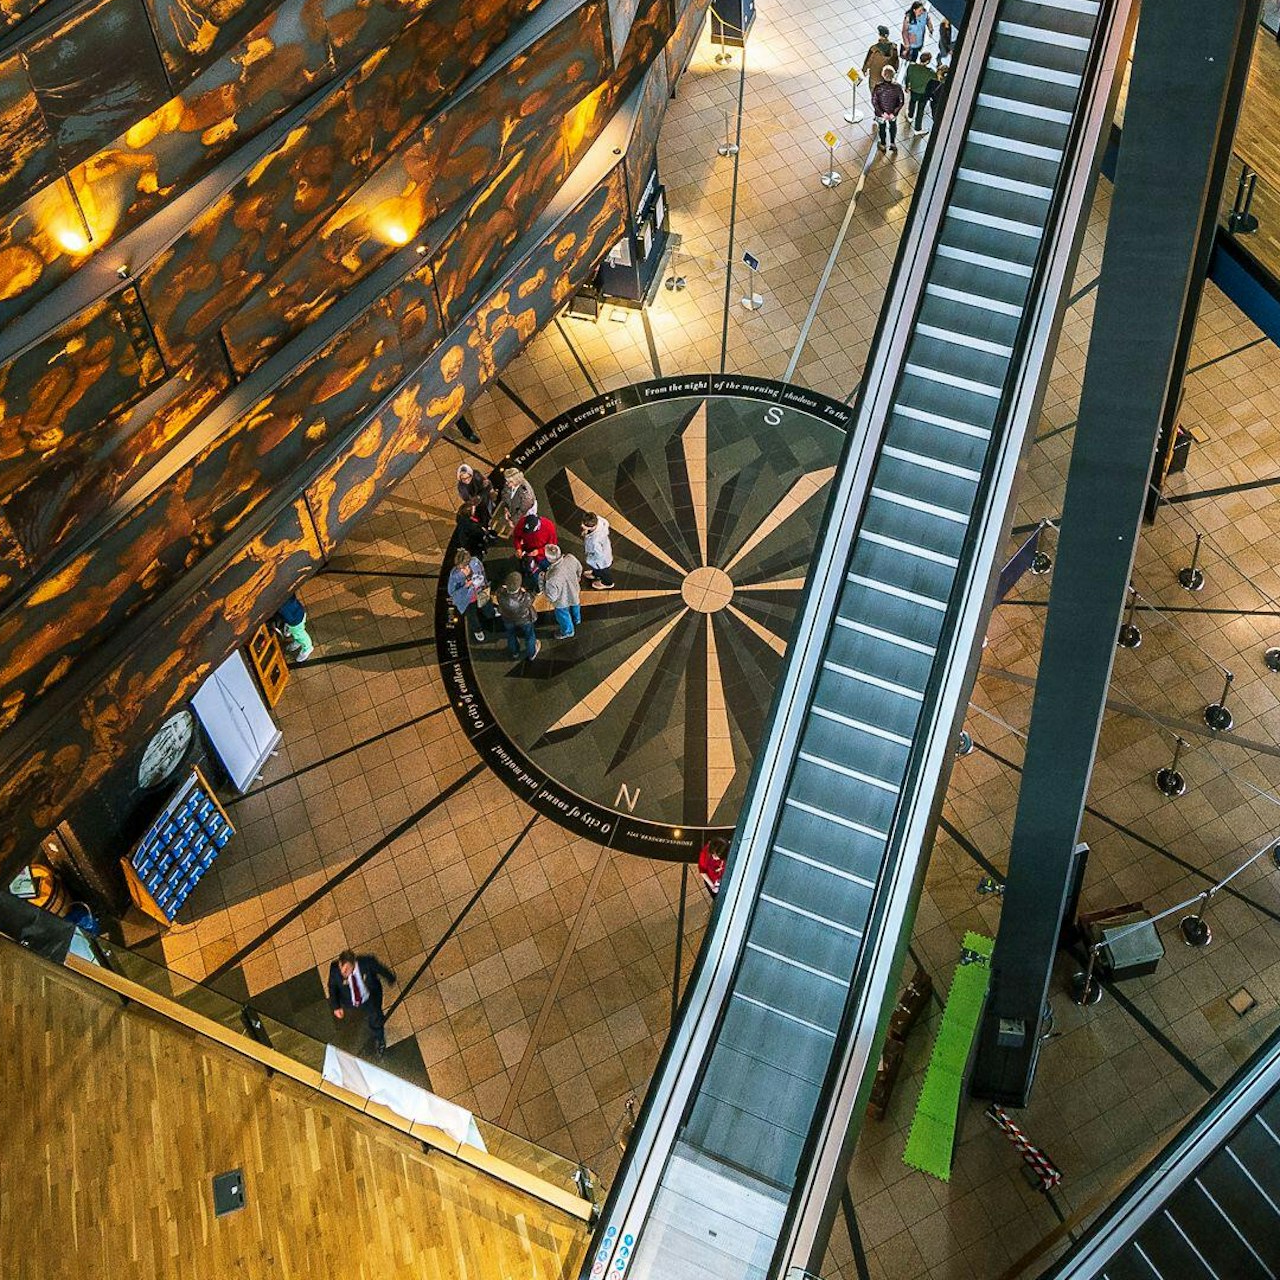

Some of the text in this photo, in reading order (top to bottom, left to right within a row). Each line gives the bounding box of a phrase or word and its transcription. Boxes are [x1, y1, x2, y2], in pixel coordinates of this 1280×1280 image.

[644, 380, 818, 408] From the night of the morning shadows
[764, 407, 783, 426] S
[823, 405, 849, 421] To the
[514, 455, 526, 465] To
[524, 446, 537, 457] the
[535, 434, 550, 451] fall
[557, 422, 569, 433] the
[573, 404, 606, 423] evening
[453, 663, 468, 694] endless
[459, 693, 474, 705] of
[467, 703, 480, 720] city
[474, 720, 485, 729] O
[490, 745, 539, 789] and motion!
[615, 782, 641, 812] N
[538, 790, 611, 833] O city of sound
